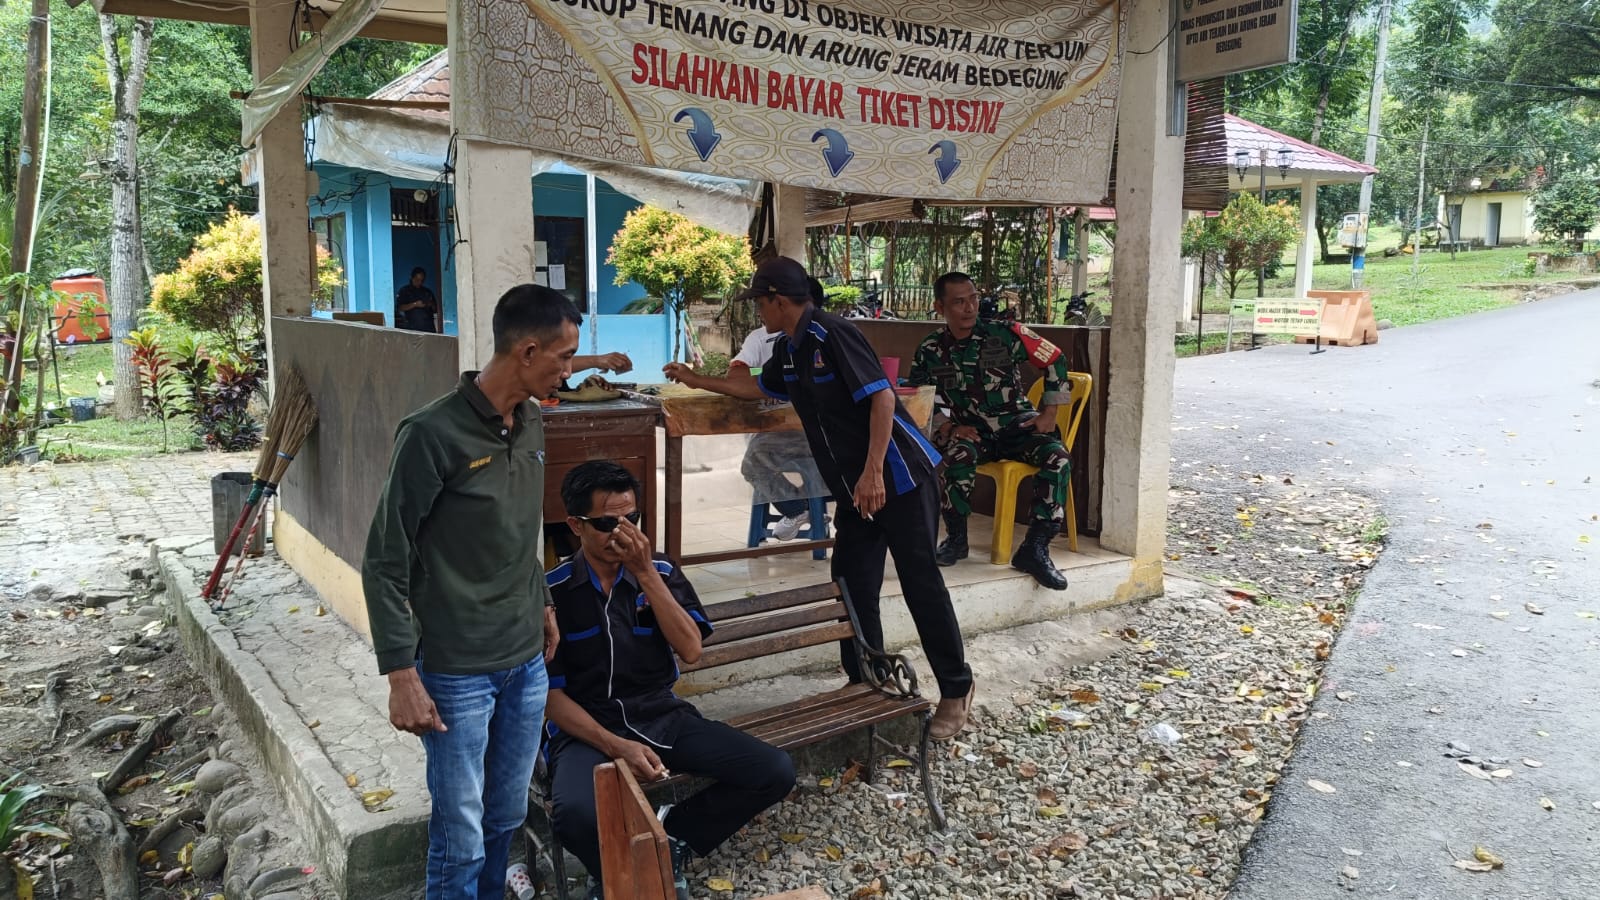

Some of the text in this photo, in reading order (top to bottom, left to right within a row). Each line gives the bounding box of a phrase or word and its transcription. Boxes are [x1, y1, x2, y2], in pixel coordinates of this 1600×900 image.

[643, 0, 749, 45] TENANG
[753, 25, 808, 57] DAN
[809, 41, 892, 72] ARUNG
[892, 54, 959, 85] JERAM
[965, 65, 1069, 91] BEDEGUNG
[783, 0, 810, 22] DI
[817, 4, 888, 38] OBJEK
[892, 20, 972, 52] WISATA
[978, 35, 1009, 60] AIR
[1014, 40, 1091, 63] TERJUN
[631, 42, 1005, 134] SILAHKAN BAYAR TIKET DISINI
